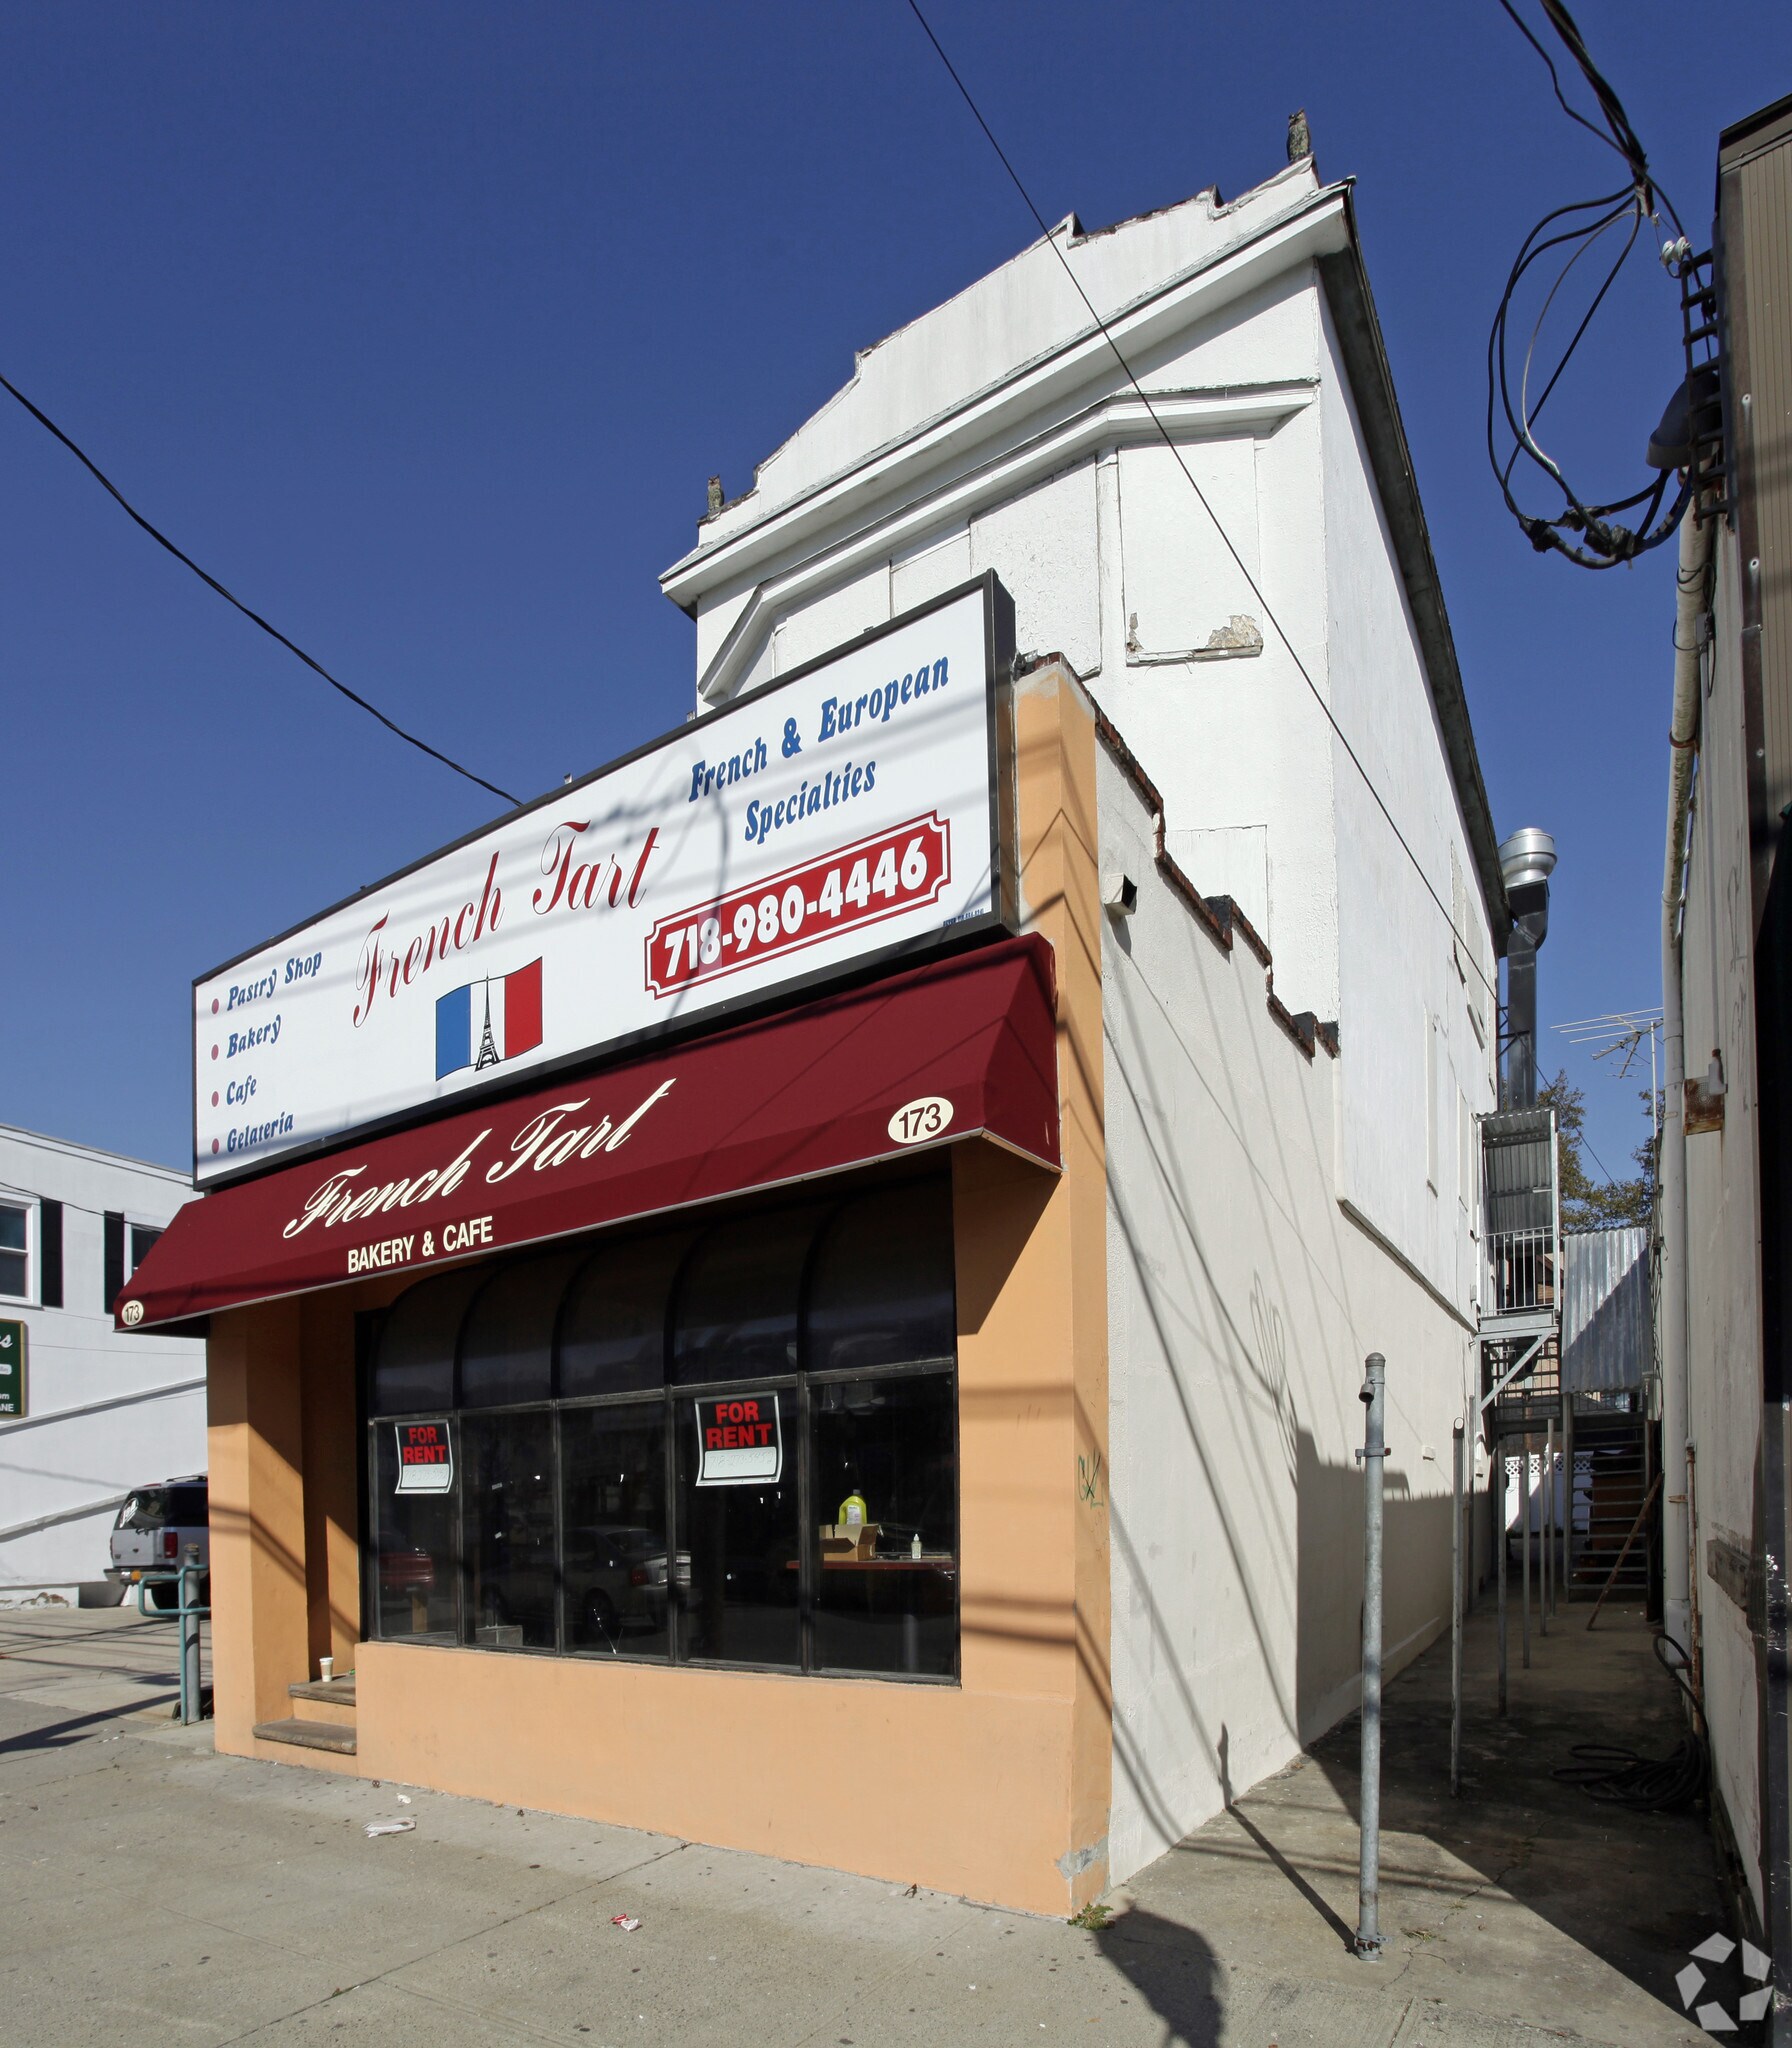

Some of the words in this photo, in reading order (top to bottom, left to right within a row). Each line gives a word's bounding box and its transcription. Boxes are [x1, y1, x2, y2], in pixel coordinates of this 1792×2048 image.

[687, 736, 768, 803] French
[781, 717, 802, 758] &
[817, 655, 950, 743] European
[744, 760, 877, 845] Specialties
[353, 850, 506, 1029] French
[532, 819, 660, 916] Tart
[664, 835, 929, 980] 718-980-4446
[226, 968, 277, 1011] Pastry
[284, 951, 322, 985] Shop
[226, 1014, 281, 1059] Bakery
[226, 1074, 257, 1106] Cafe
[226, 1111, 294, 1153] Gelateria
[898, 1102, 942, 1139] 173
[282, 1127, 493, 1239] French
[485, 1077, 677, 1184] Tart
[347, 1234, 414, 1274] BAKERY
[421, 1230, 435, 1257] &
[442, 1214, 494, 1252] CAFE
[125, 1304, 140, 1322] 173
[715, 1400, 760, 1424] FOR
[402, 1444, 446, 1464] RENT
[408, 1426, 438, 1445] FOR
[706, 1423, 772, 1450] RENT
